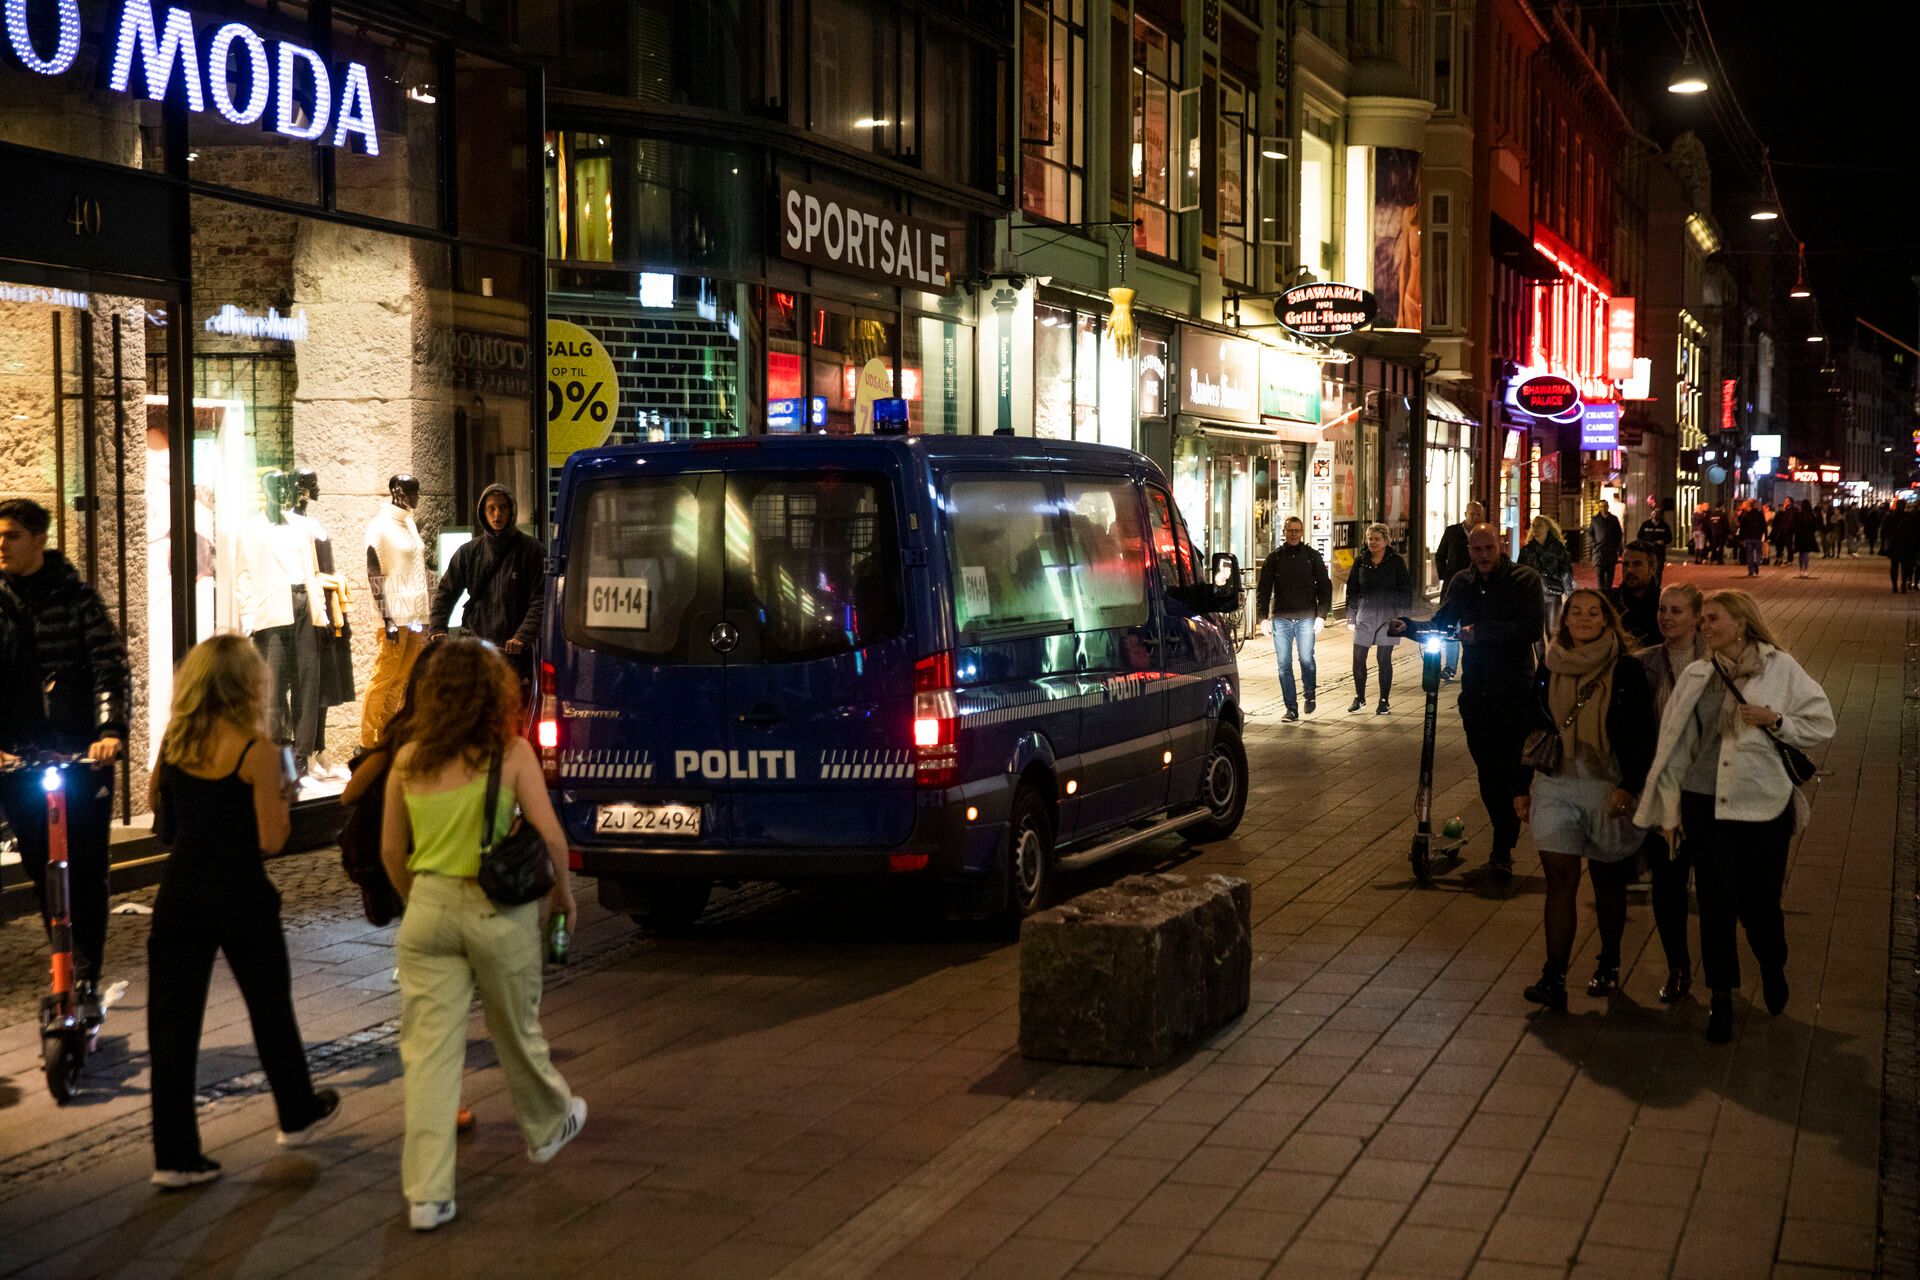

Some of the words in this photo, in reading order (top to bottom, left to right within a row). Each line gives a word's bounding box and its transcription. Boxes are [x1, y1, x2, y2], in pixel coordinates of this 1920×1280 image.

[109, 0, 380, 157] MODA
[66, 195, 103, 238] 40
[786, 189, 946, 288] SPORTSALE
[1286, 286, 1364, 305] SHAWARMA
[1284, 310, 1366, 325] Grill-House
[552, 367, 568, 377] OP
[571, 367, 588, 377] TIL
[864, 372, 891, 394] UDSALG
[1522, 385, 1572, 396] SHAWARMA
[1530, 395, 1564, 407] PALACE
[1585, 411, 1615, 420] CHANGE
[1793, 471, 1819, 482] PIZZA
[592, 585, 644, 613] G11-14
[1107, 672, 1141, 703] POLITI
[674, 749, 797, 780] POLITI
[601, 810, 626, 830] ZJ
[632, 809, 697, 830] 22494
